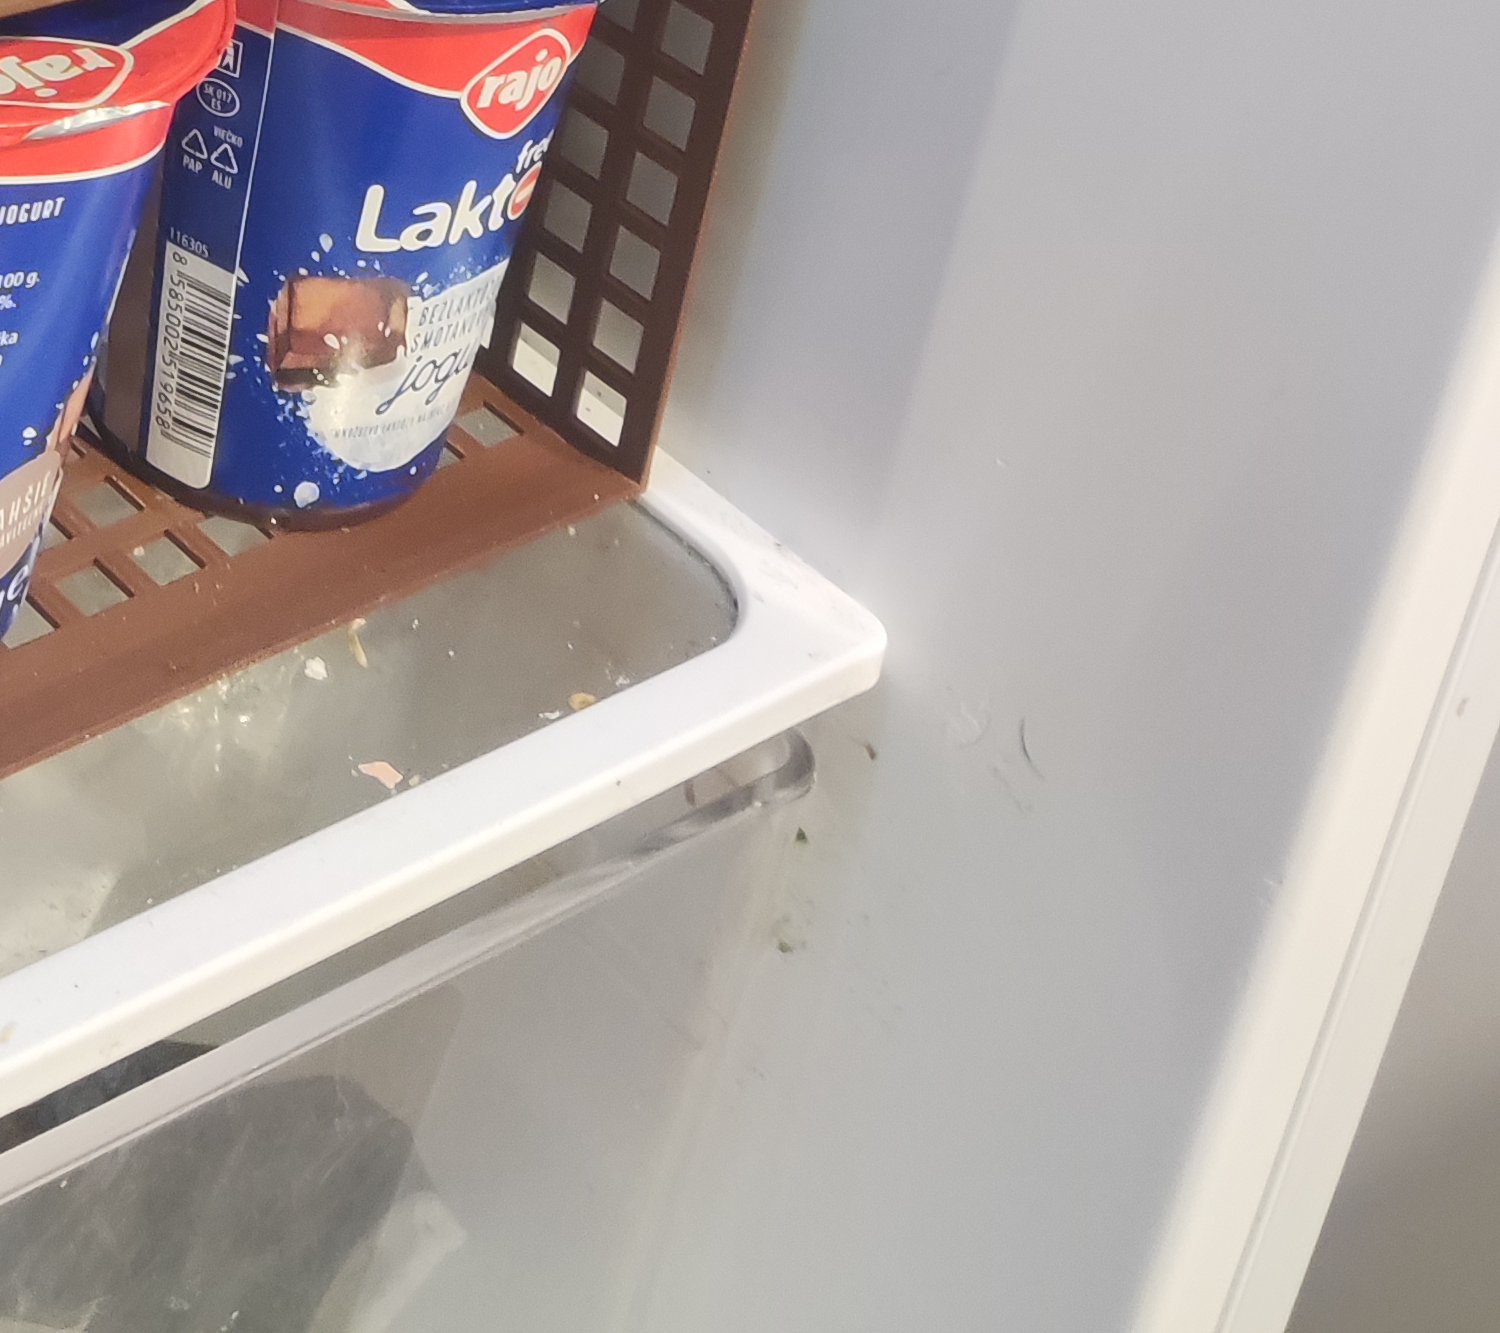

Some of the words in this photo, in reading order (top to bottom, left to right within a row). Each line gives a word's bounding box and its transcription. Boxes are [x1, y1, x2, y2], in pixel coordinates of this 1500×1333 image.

[475, 48, 562, 112] rajo
[211, 97, 222, 112] ES
[182, 154, 203, 174] PAP
[211, 170, 233, 190] ALU
